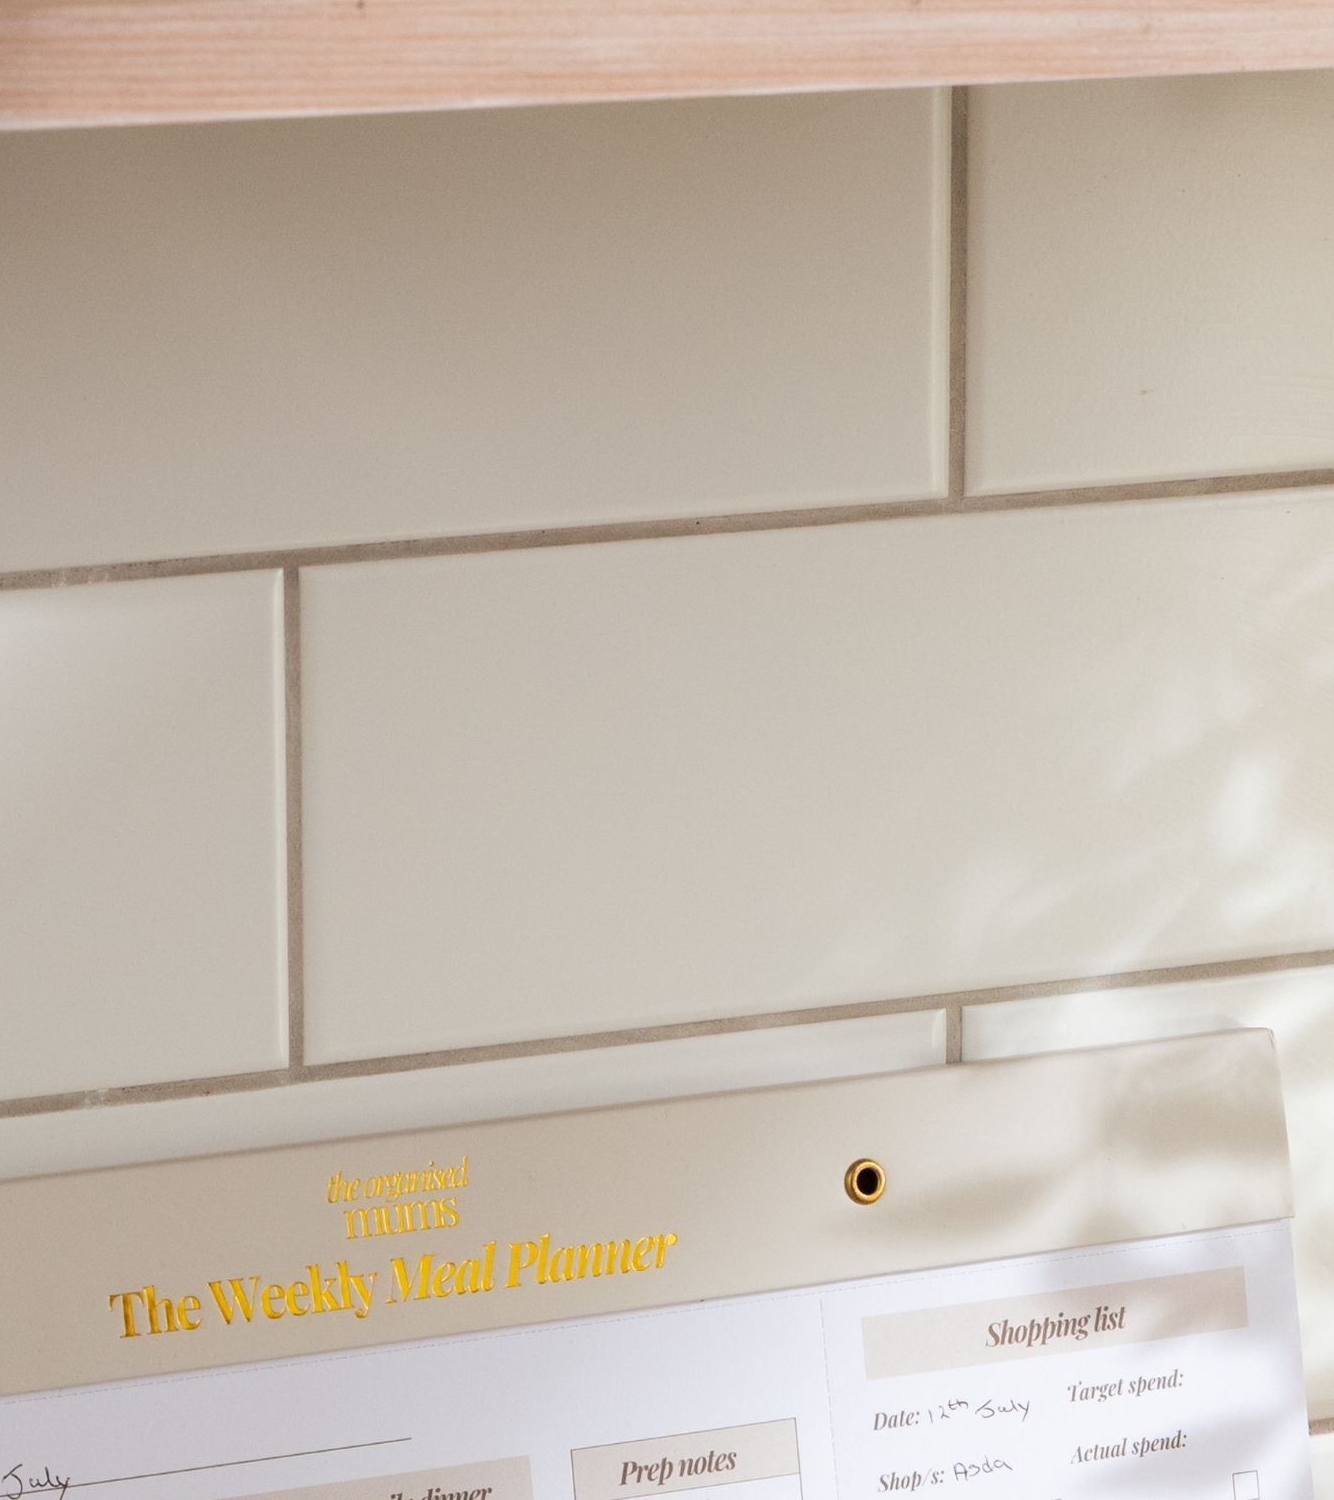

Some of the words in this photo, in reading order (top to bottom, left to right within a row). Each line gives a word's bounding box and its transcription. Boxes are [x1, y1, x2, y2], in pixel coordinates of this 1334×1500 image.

[327, 1171, 361, 1203] the
[363, 1156, 468, 1202] organised
[343, 1197, 460, 1240] mums
[109, 1285, 201, 1339] The
[207, 1260, 378, 1320] Weekly
[386, 1238, 497, 1304] Meal
[502, 1232, 678, 1289] Planner
[985, 1312, 1092, 1349] Shopping
[1094, 1306, 1127, 1333] list
[1067, 1378, 1125, 1403] Target
[1128, 1370, 1185, 1397] spend:
[873, 1409, 921, 1432] Date:
[1071, 1438, 1127, 1465] Actual
[1131, 1431, 1188, 1458] spend:
[619, 1454, 674, 1487] Prep
[678, 1449, 737, 1479] notes
[877, 1469, 946, 1494] Shop/s:
